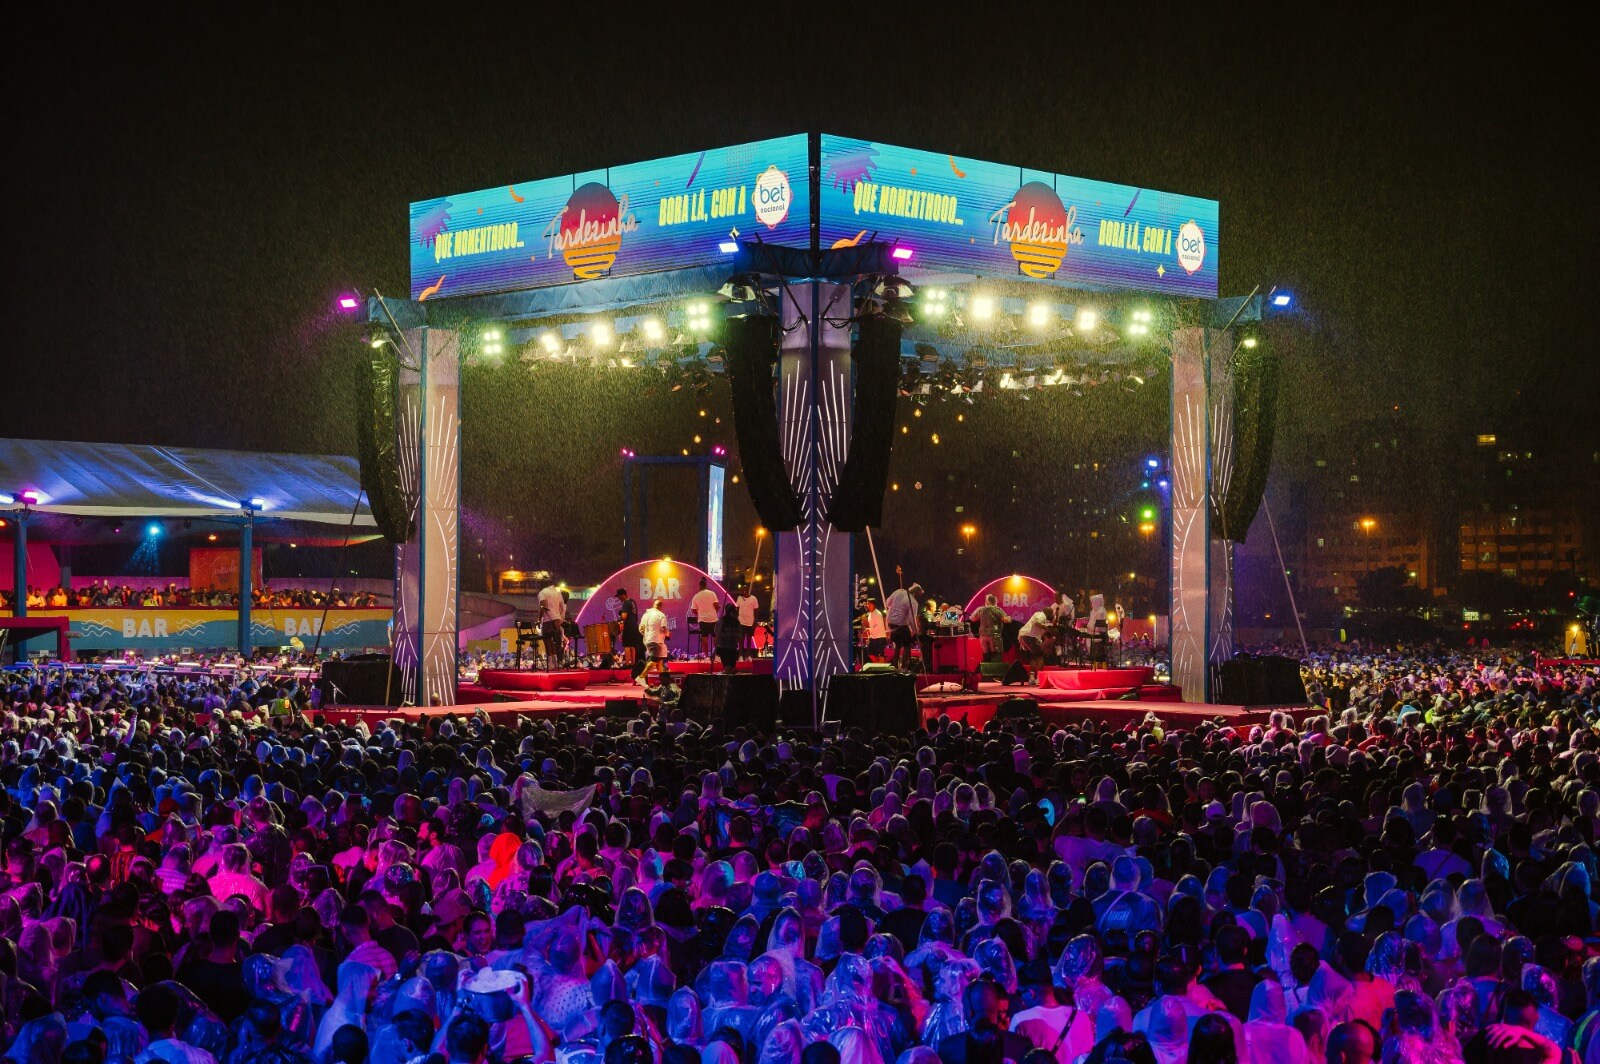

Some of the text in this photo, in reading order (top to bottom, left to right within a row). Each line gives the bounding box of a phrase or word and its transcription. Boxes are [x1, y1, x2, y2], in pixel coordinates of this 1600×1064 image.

[658, 185, 746, 227] BORA LÁ, COM A
[760, 182, 785, 204] bet
[853, 181, 878, 215] QUE
[542, 193, 639, 259] Tardezinha
[989, 200, 1084, 246] Tardezinha
[434, 232, 453, 264] QUE
[1098, 219, 1172, 255] BORA LÁ, COM A
[1181, 232, 1201, 254] bet
[639, 577, 682, 600] BAR
[1002, 592, 1029, 608] BAR
[122, 618, 169, 638] BAR
[284, 617, 326, 637] BAR
